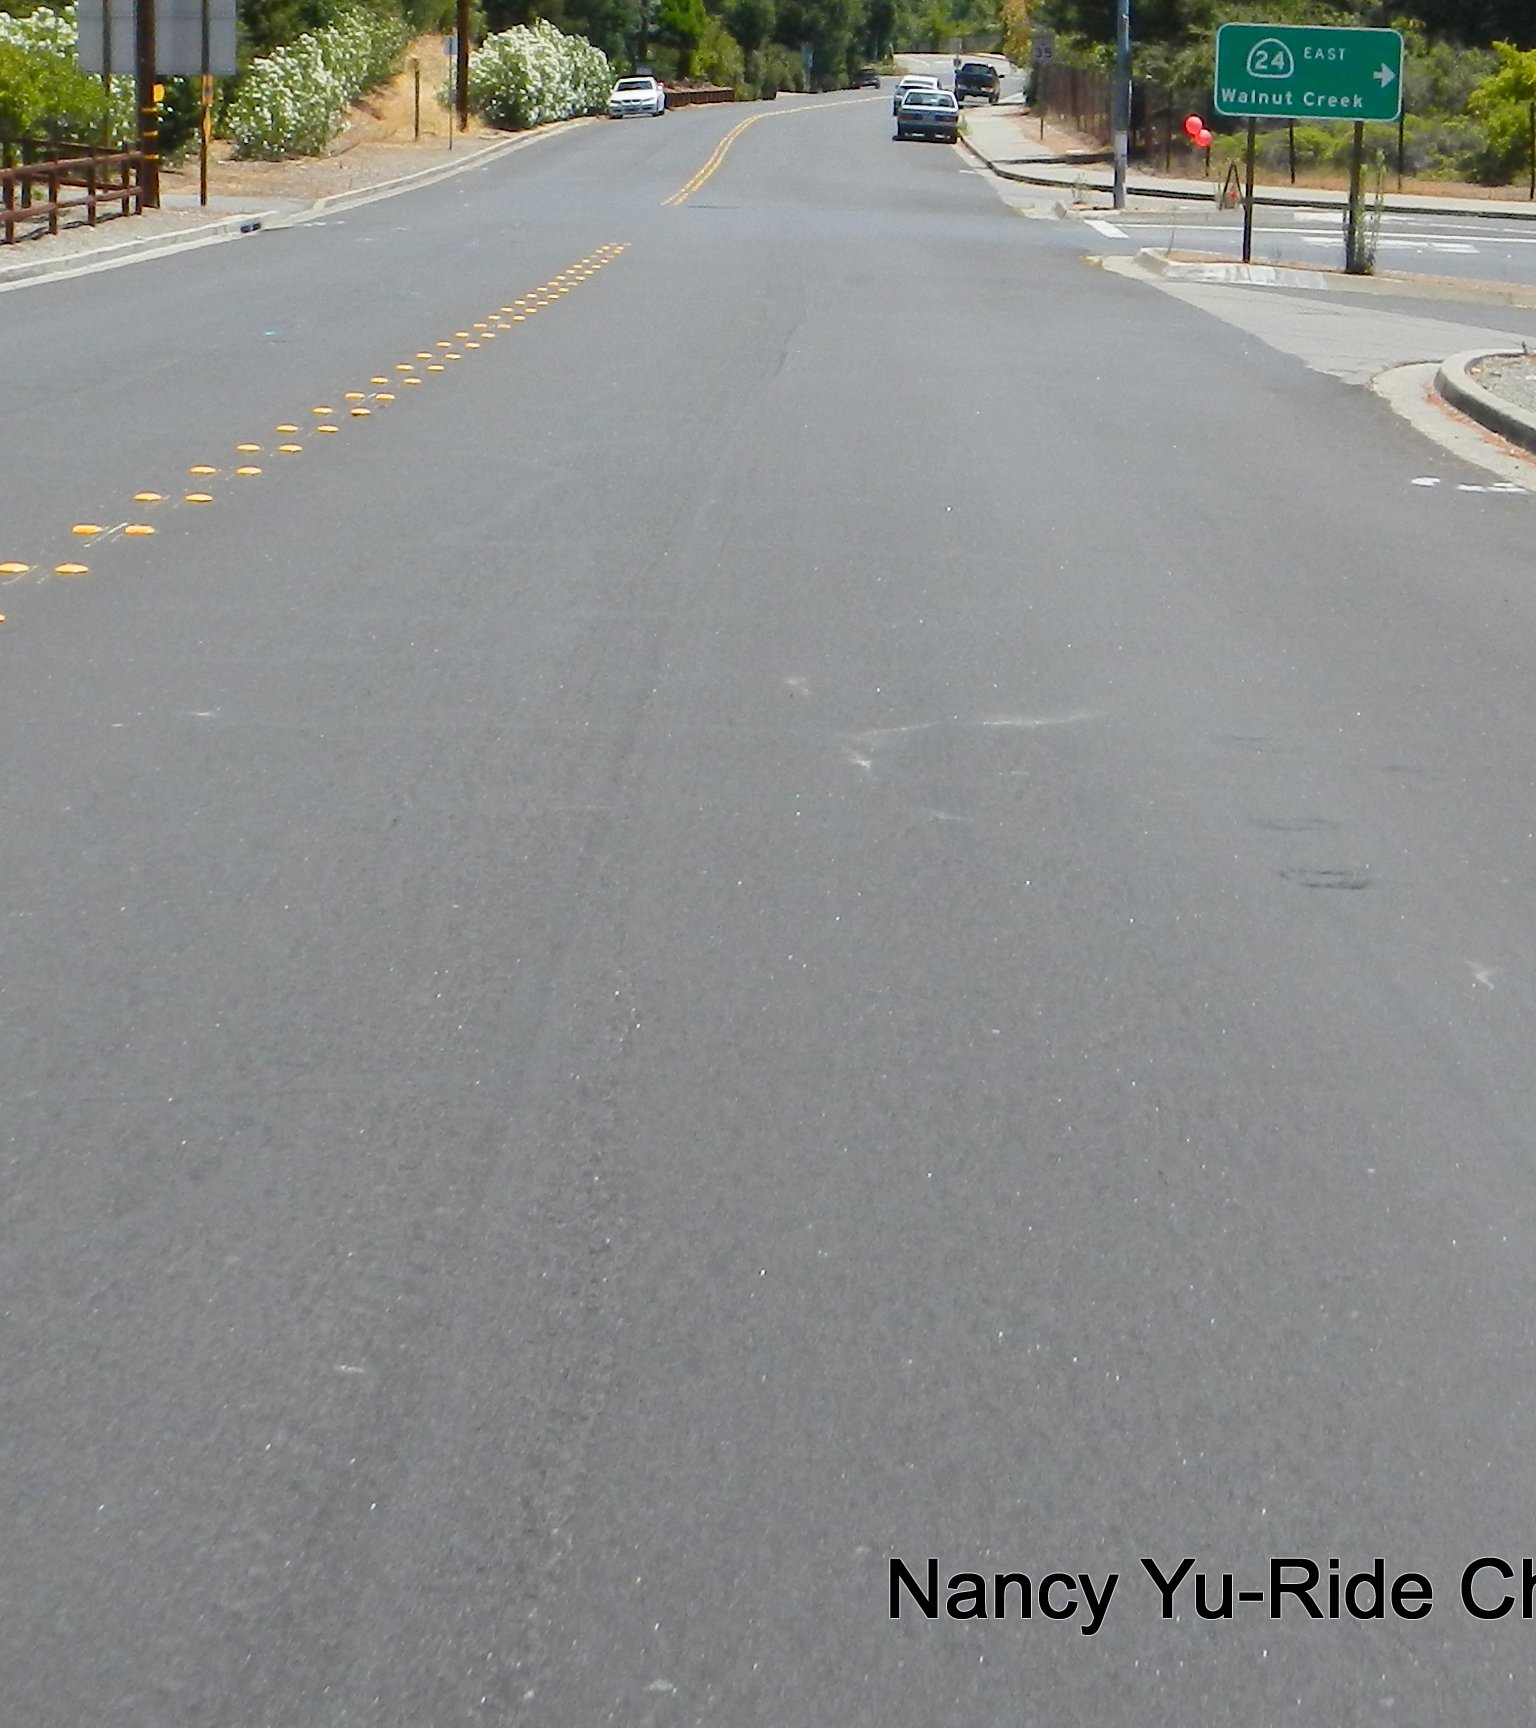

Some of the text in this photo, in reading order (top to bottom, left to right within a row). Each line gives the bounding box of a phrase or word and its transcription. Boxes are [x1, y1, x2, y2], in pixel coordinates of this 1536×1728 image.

[1254, 50, 1285, 71] 24
[1303, 46, 1346, 61] EAST
[1221, 87, 1364, 109] Walnut Creek
